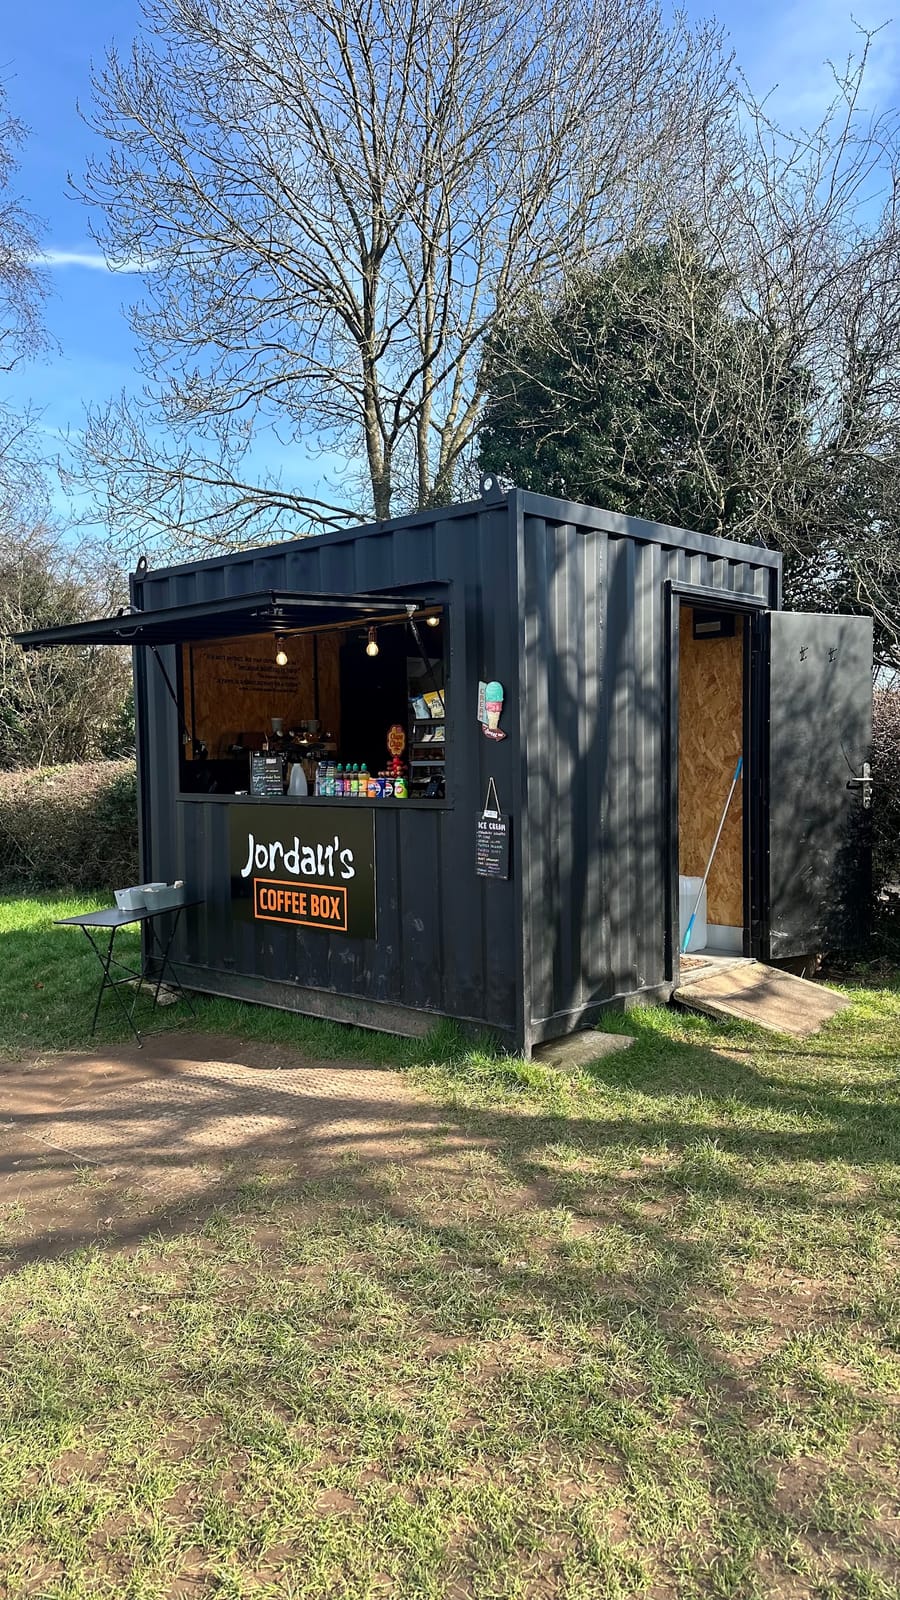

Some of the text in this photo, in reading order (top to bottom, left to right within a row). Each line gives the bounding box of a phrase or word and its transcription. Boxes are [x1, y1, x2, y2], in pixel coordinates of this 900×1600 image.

[478, 821, 506, 831] ICE CREAM
[241, 833, 355, 879] Jordan's
[260, 888, 341, 920] COFFEE BOX
